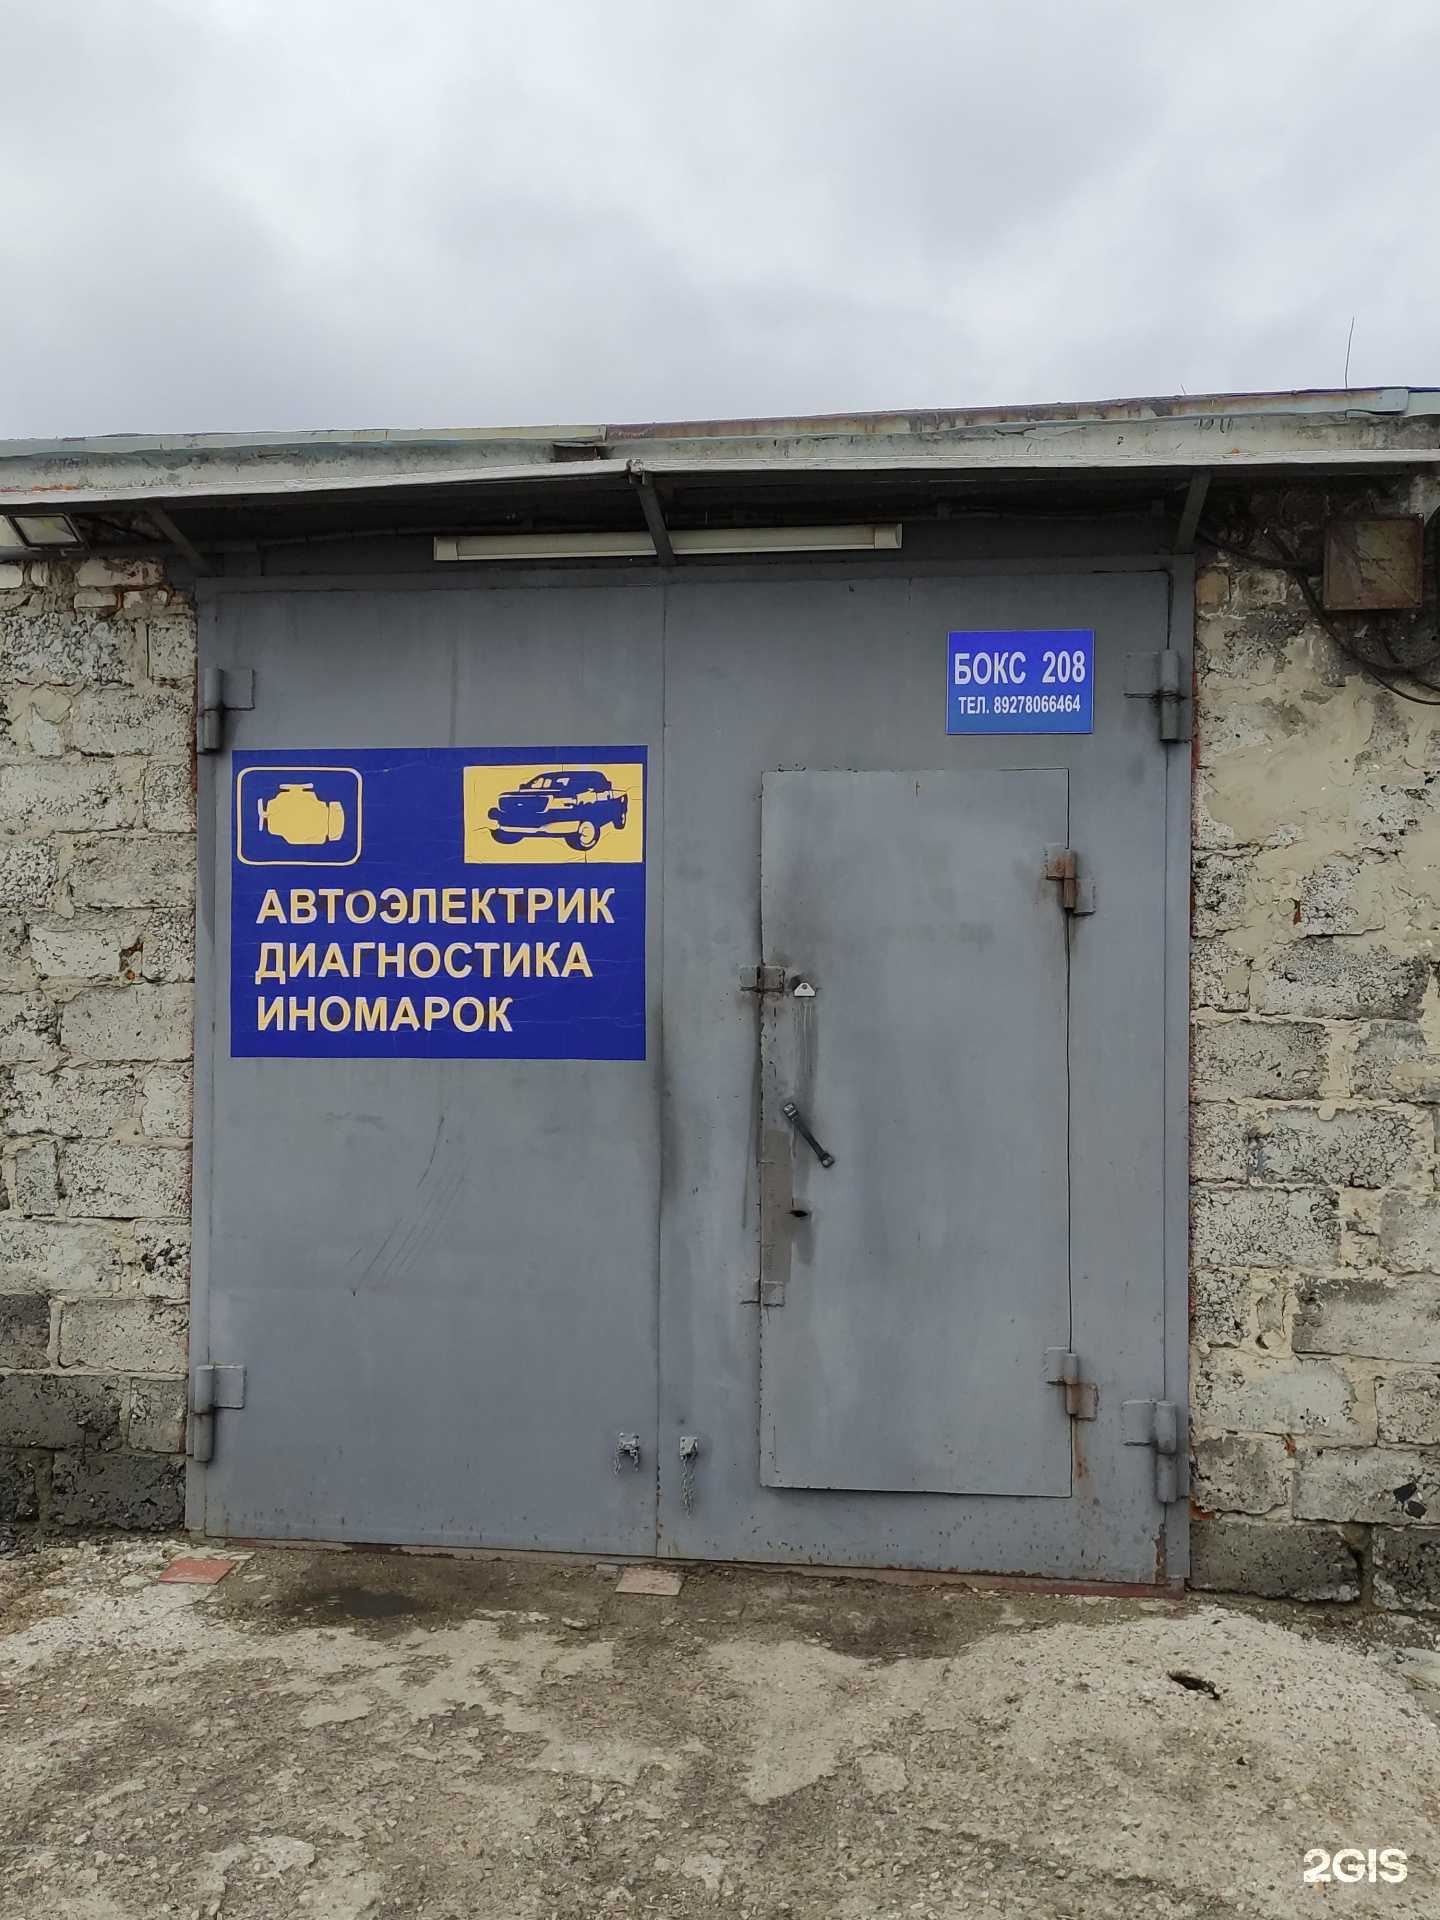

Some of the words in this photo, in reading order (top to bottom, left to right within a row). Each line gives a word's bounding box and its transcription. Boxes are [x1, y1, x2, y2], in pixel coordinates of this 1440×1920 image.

[954, 652, 1026, 684] БОКС
[1042, 650, 1086, 683] 208
[958, 696, 990, 714] ТЕЛ.
[993, 694, 1081, 713] 89278066464
[256, 888, 615, 924] АВТОЭЛЕКТРИК
[255, 942, 593, 985] ДИАГНОСТИКА
[257, 996, 513, 1032] ИНОМАРОК
